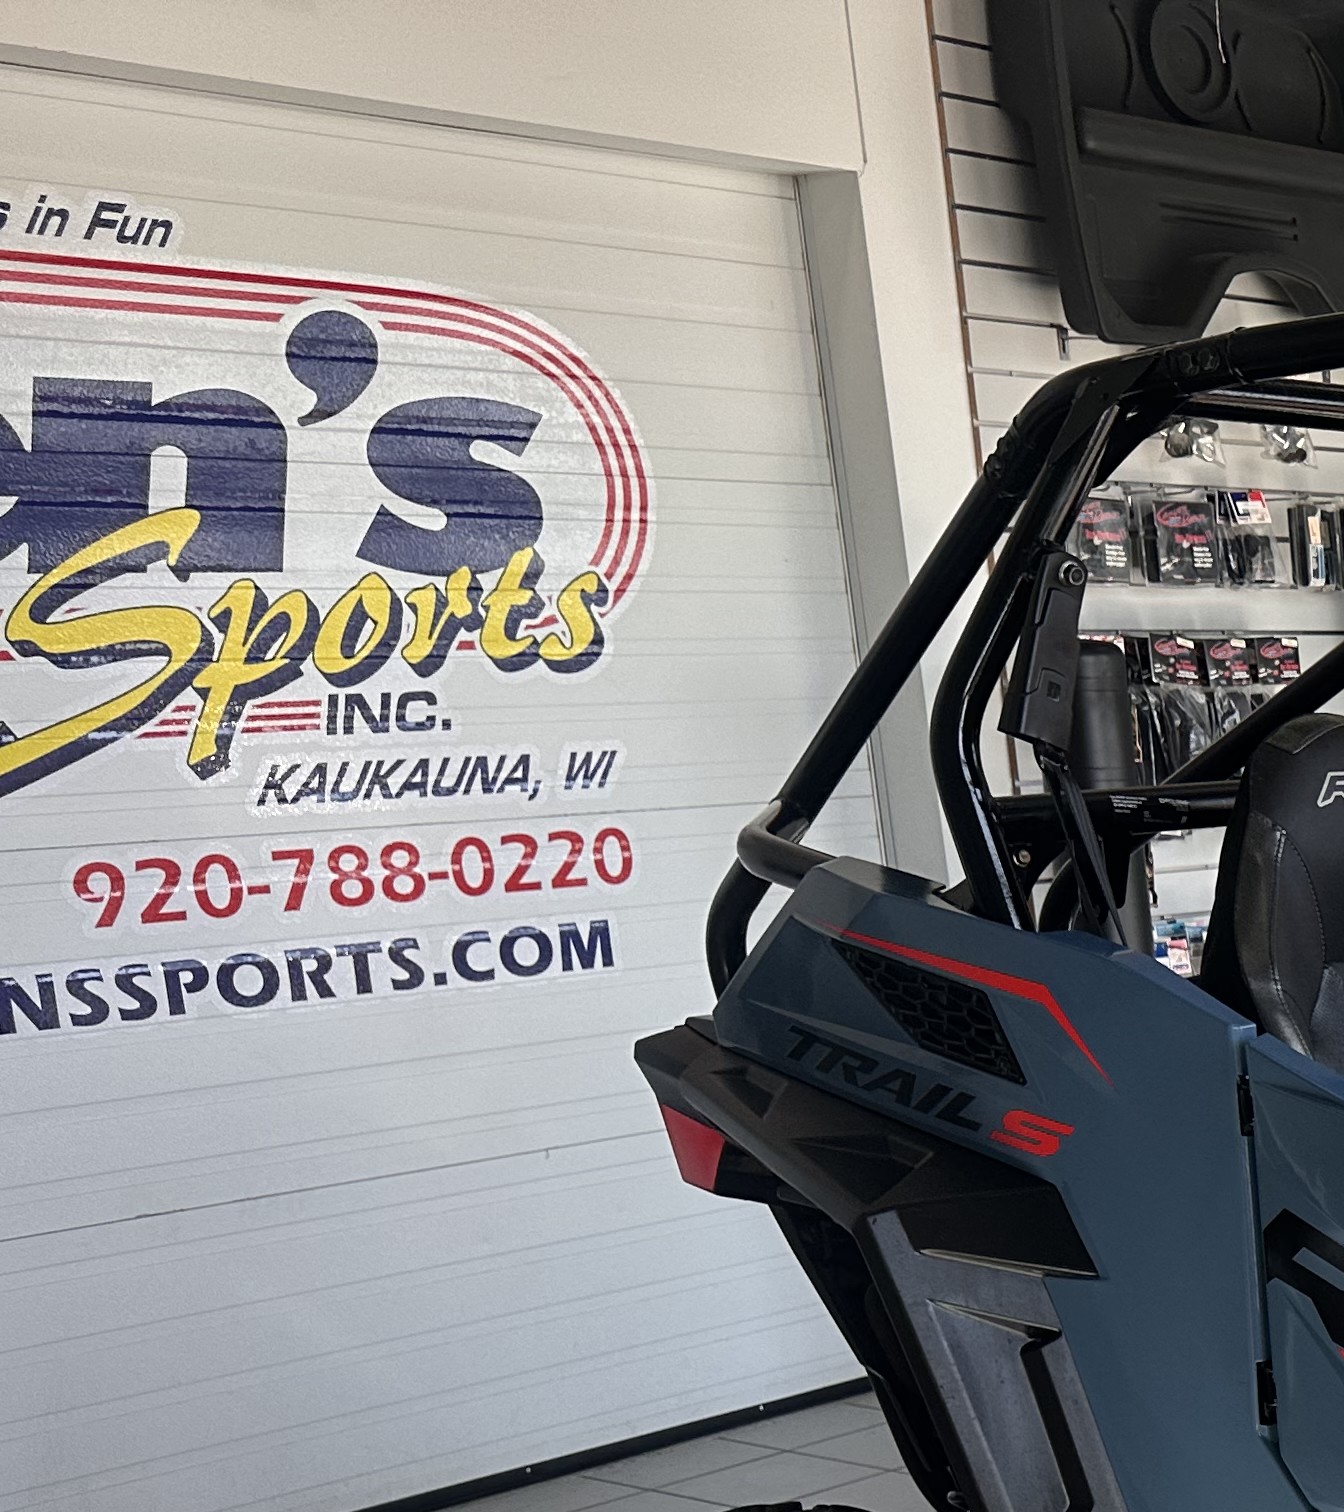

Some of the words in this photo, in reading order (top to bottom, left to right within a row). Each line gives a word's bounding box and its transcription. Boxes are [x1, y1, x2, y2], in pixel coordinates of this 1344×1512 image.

[25, 194, 70, 237] in
[83, 200, 173, 248] Fun
[0, 309, 546, 577] n's
[0, 507, 610, 797] Sports
[325, 691, 452, 735] INC.
[256, 753, 541, 807] KAUKAUNA,
[563, 750, 617, 791] WI
[72, 826, 634, 928] 920-788-0220
[0, 919, 615, 1035] NSSPORTS.COM
[786, 1024, 983, 1133] TRAIL
[988, 1108, 1076, 1158] S
